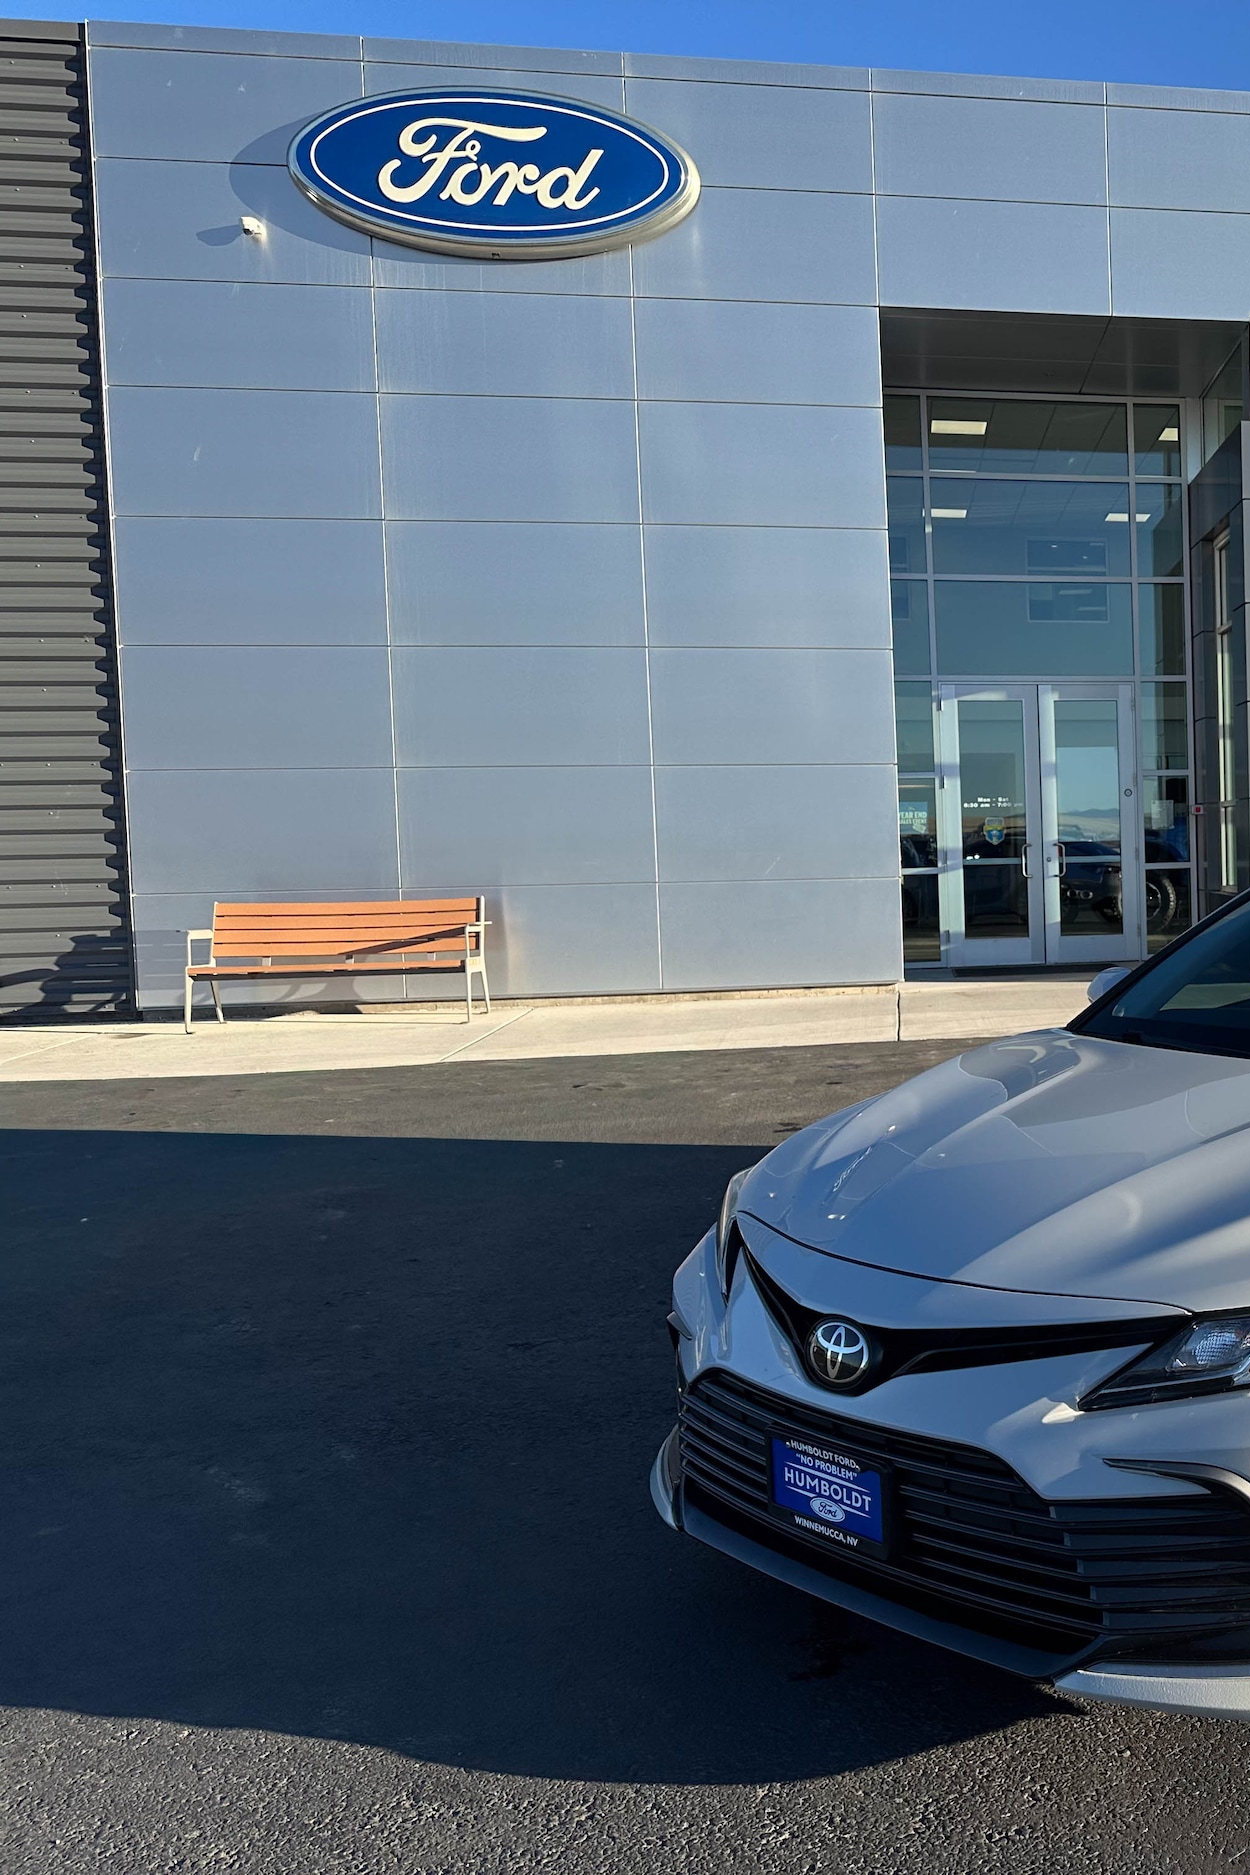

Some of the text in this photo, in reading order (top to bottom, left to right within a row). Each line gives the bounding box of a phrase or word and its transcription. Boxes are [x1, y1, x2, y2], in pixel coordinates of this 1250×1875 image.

[378, 117, 604, 211] Ford
[914, 811, 928, 819] END
[790, 1439, 856, 1468] HUMBOLDT FORD
[784, 1466, 872, 1512] HUMBOLDT
[818, 1501, 838, 1518] Ford
[794, 1515, 859, 1547] WINNEMUCCA, NV
